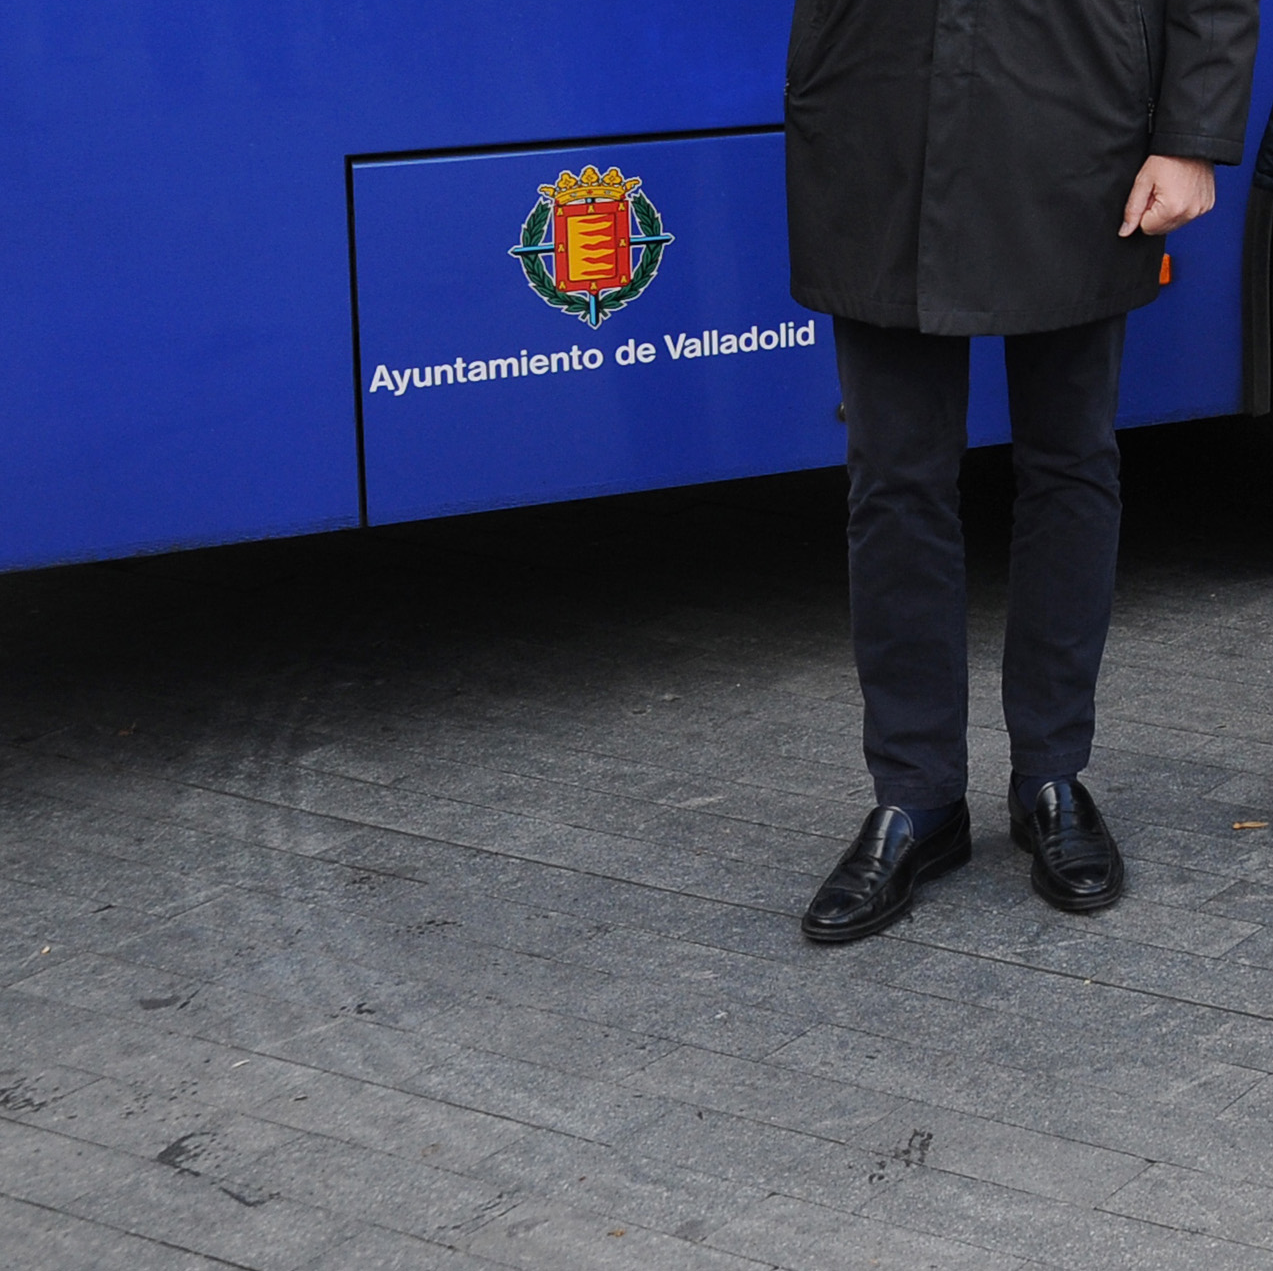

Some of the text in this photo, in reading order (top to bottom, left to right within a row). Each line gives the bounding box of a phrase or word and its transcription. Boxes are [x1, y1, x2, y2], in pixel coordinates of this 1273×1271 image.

[369, 320, 816, 396] Ayuntamiento de Valladolid
